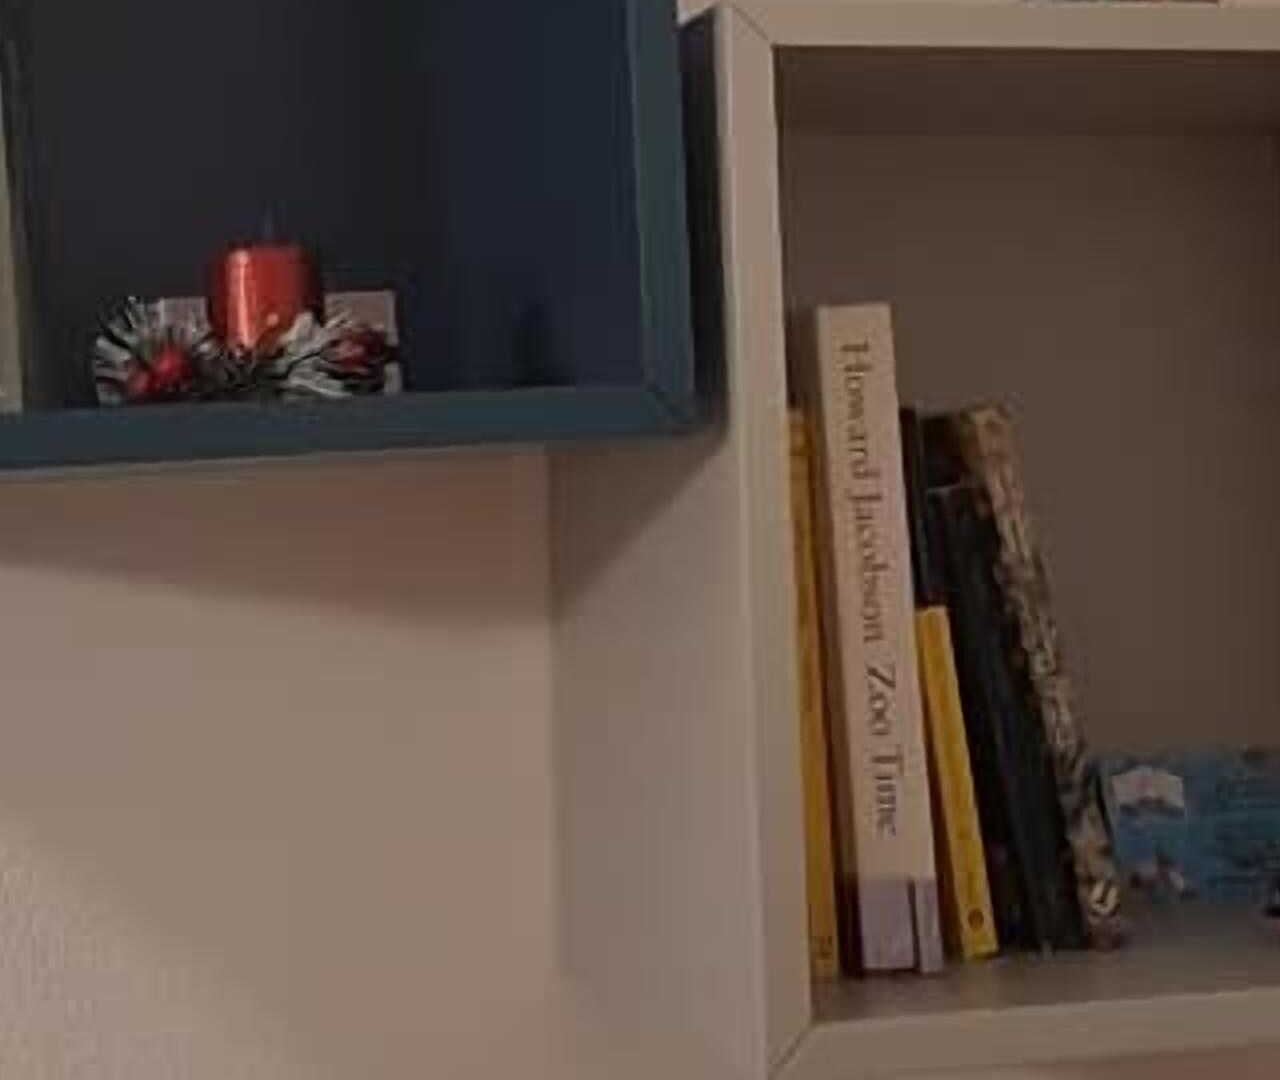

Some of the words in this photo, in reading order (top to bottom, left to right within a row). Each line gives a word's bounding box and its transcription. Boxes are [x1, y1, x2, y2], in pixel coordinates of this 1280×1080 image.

[841, 342, 881, 480] Howard
[846, 489, 887, 644] Jacobson
[865, 663, 897, 736] Zoo
[873, 744, 904, 838] Time
